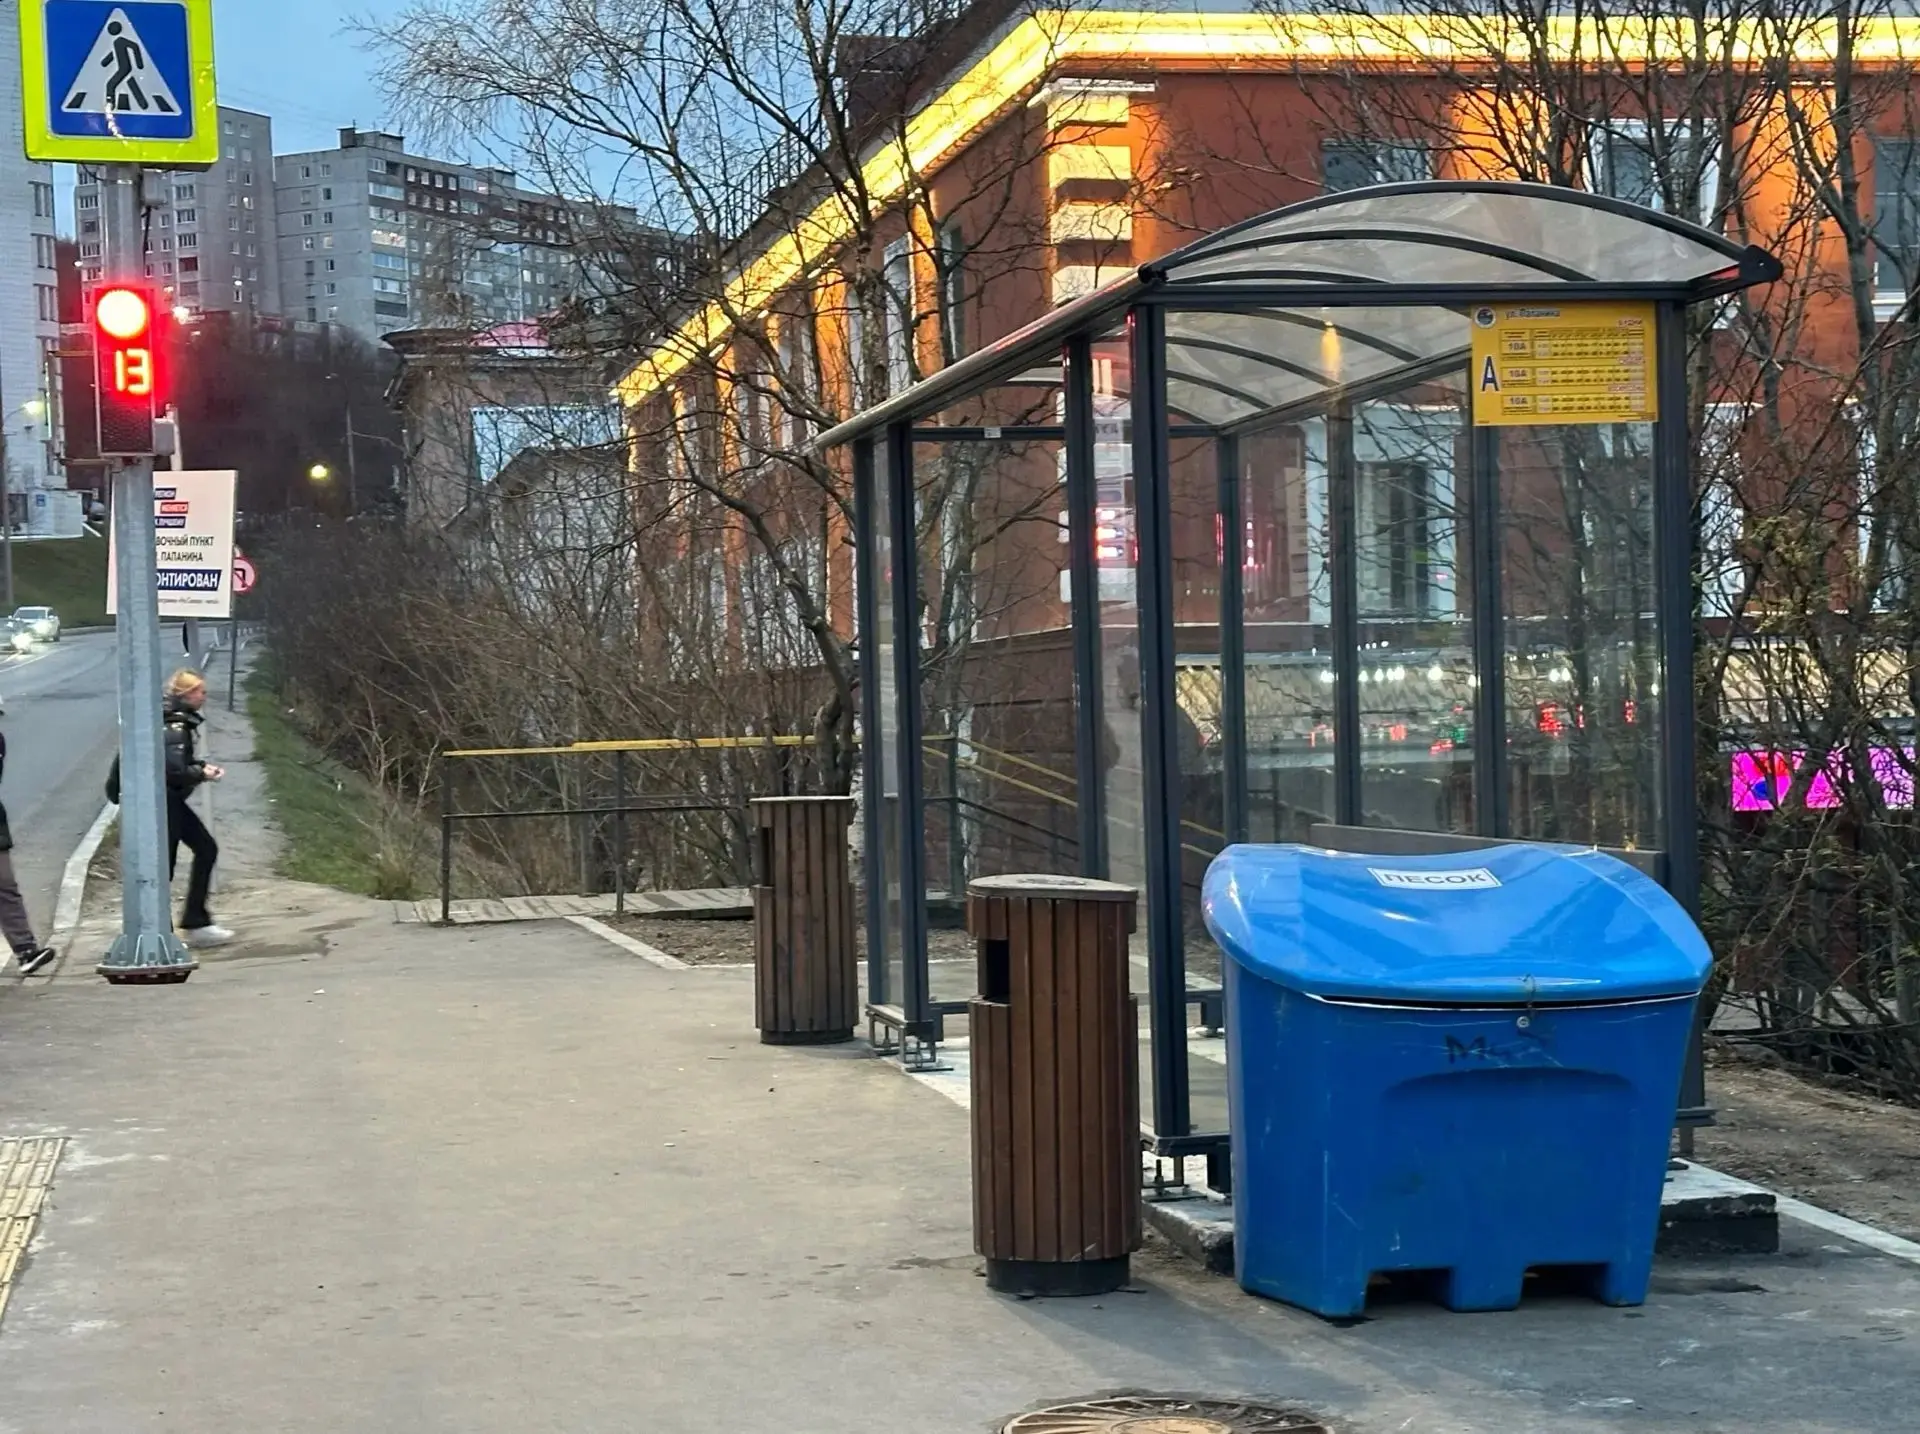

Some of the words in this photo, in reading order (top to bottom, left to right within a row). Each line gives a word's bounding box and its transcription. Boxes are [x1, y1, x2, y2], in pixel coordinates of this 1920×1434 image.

[115, 348, 150, 395] 13
[1481, 355, 1500, 392] А
[155, 534, 188, 546] ВОЧНЫЙ
[189, 536, 214, 546] ПУНКТ
[161, 551, 203, 562] ПАПАНИНА
[156, 572, 218, 588] ОНТИРОВАН
[1383, 873, 1487, 884] ПЕСОК
